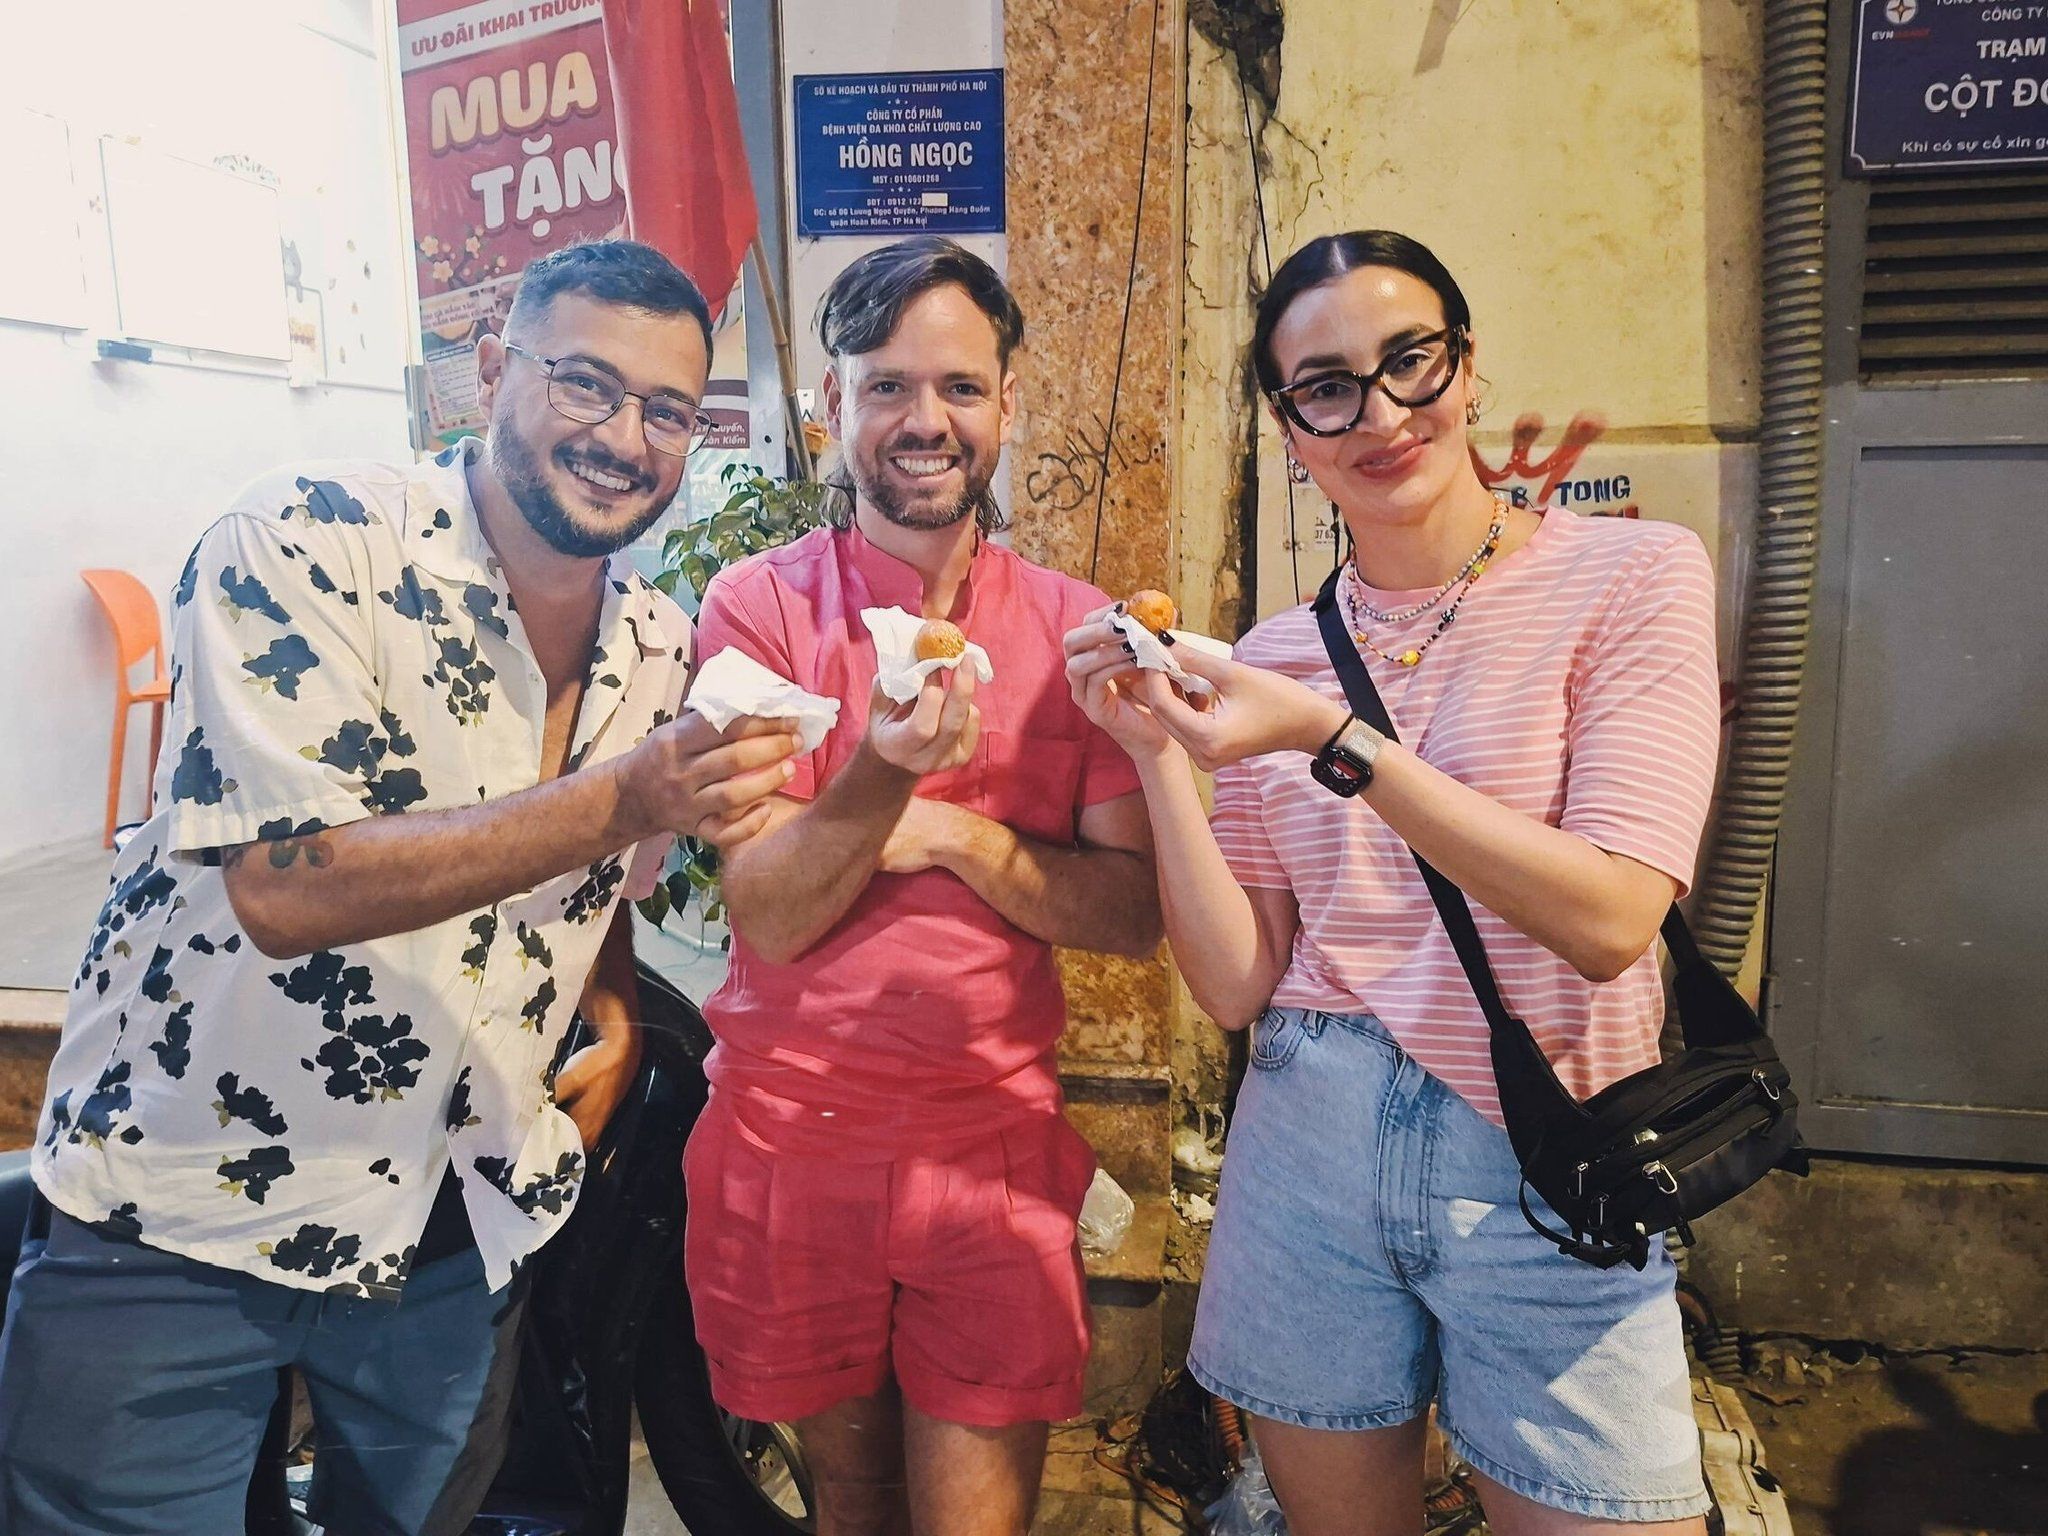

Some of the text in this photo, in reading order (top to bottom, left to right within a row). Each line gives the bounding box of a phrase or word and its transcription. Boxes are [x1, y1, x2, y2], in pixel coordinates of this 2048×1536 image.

[1982, 6, 2045, 21] CÔNG TY
[412, 35, 438, 56] ƯU
[441, 22, 475, 48] ĐÃI
[479, 10, 525, 38] KHAI
[1976, 37, 2046, 63] TRẠM
[431, 51, 599, 151] MUA
[1924, 73, 2003, 118] CỘT
[866, 107, 890, 121] CÔNG
[892, 109, 903, 120] TY
[883, 123, 906, 133] KHOA
[963, 120, 982, 131] CAO
[839, 136, 973, 172] HỒNG NGỌC
[1902, 141, 1928, 153] Khi
[2006, 136, 2031, 149] xin
[471, 133, 625, 238] TẶN
